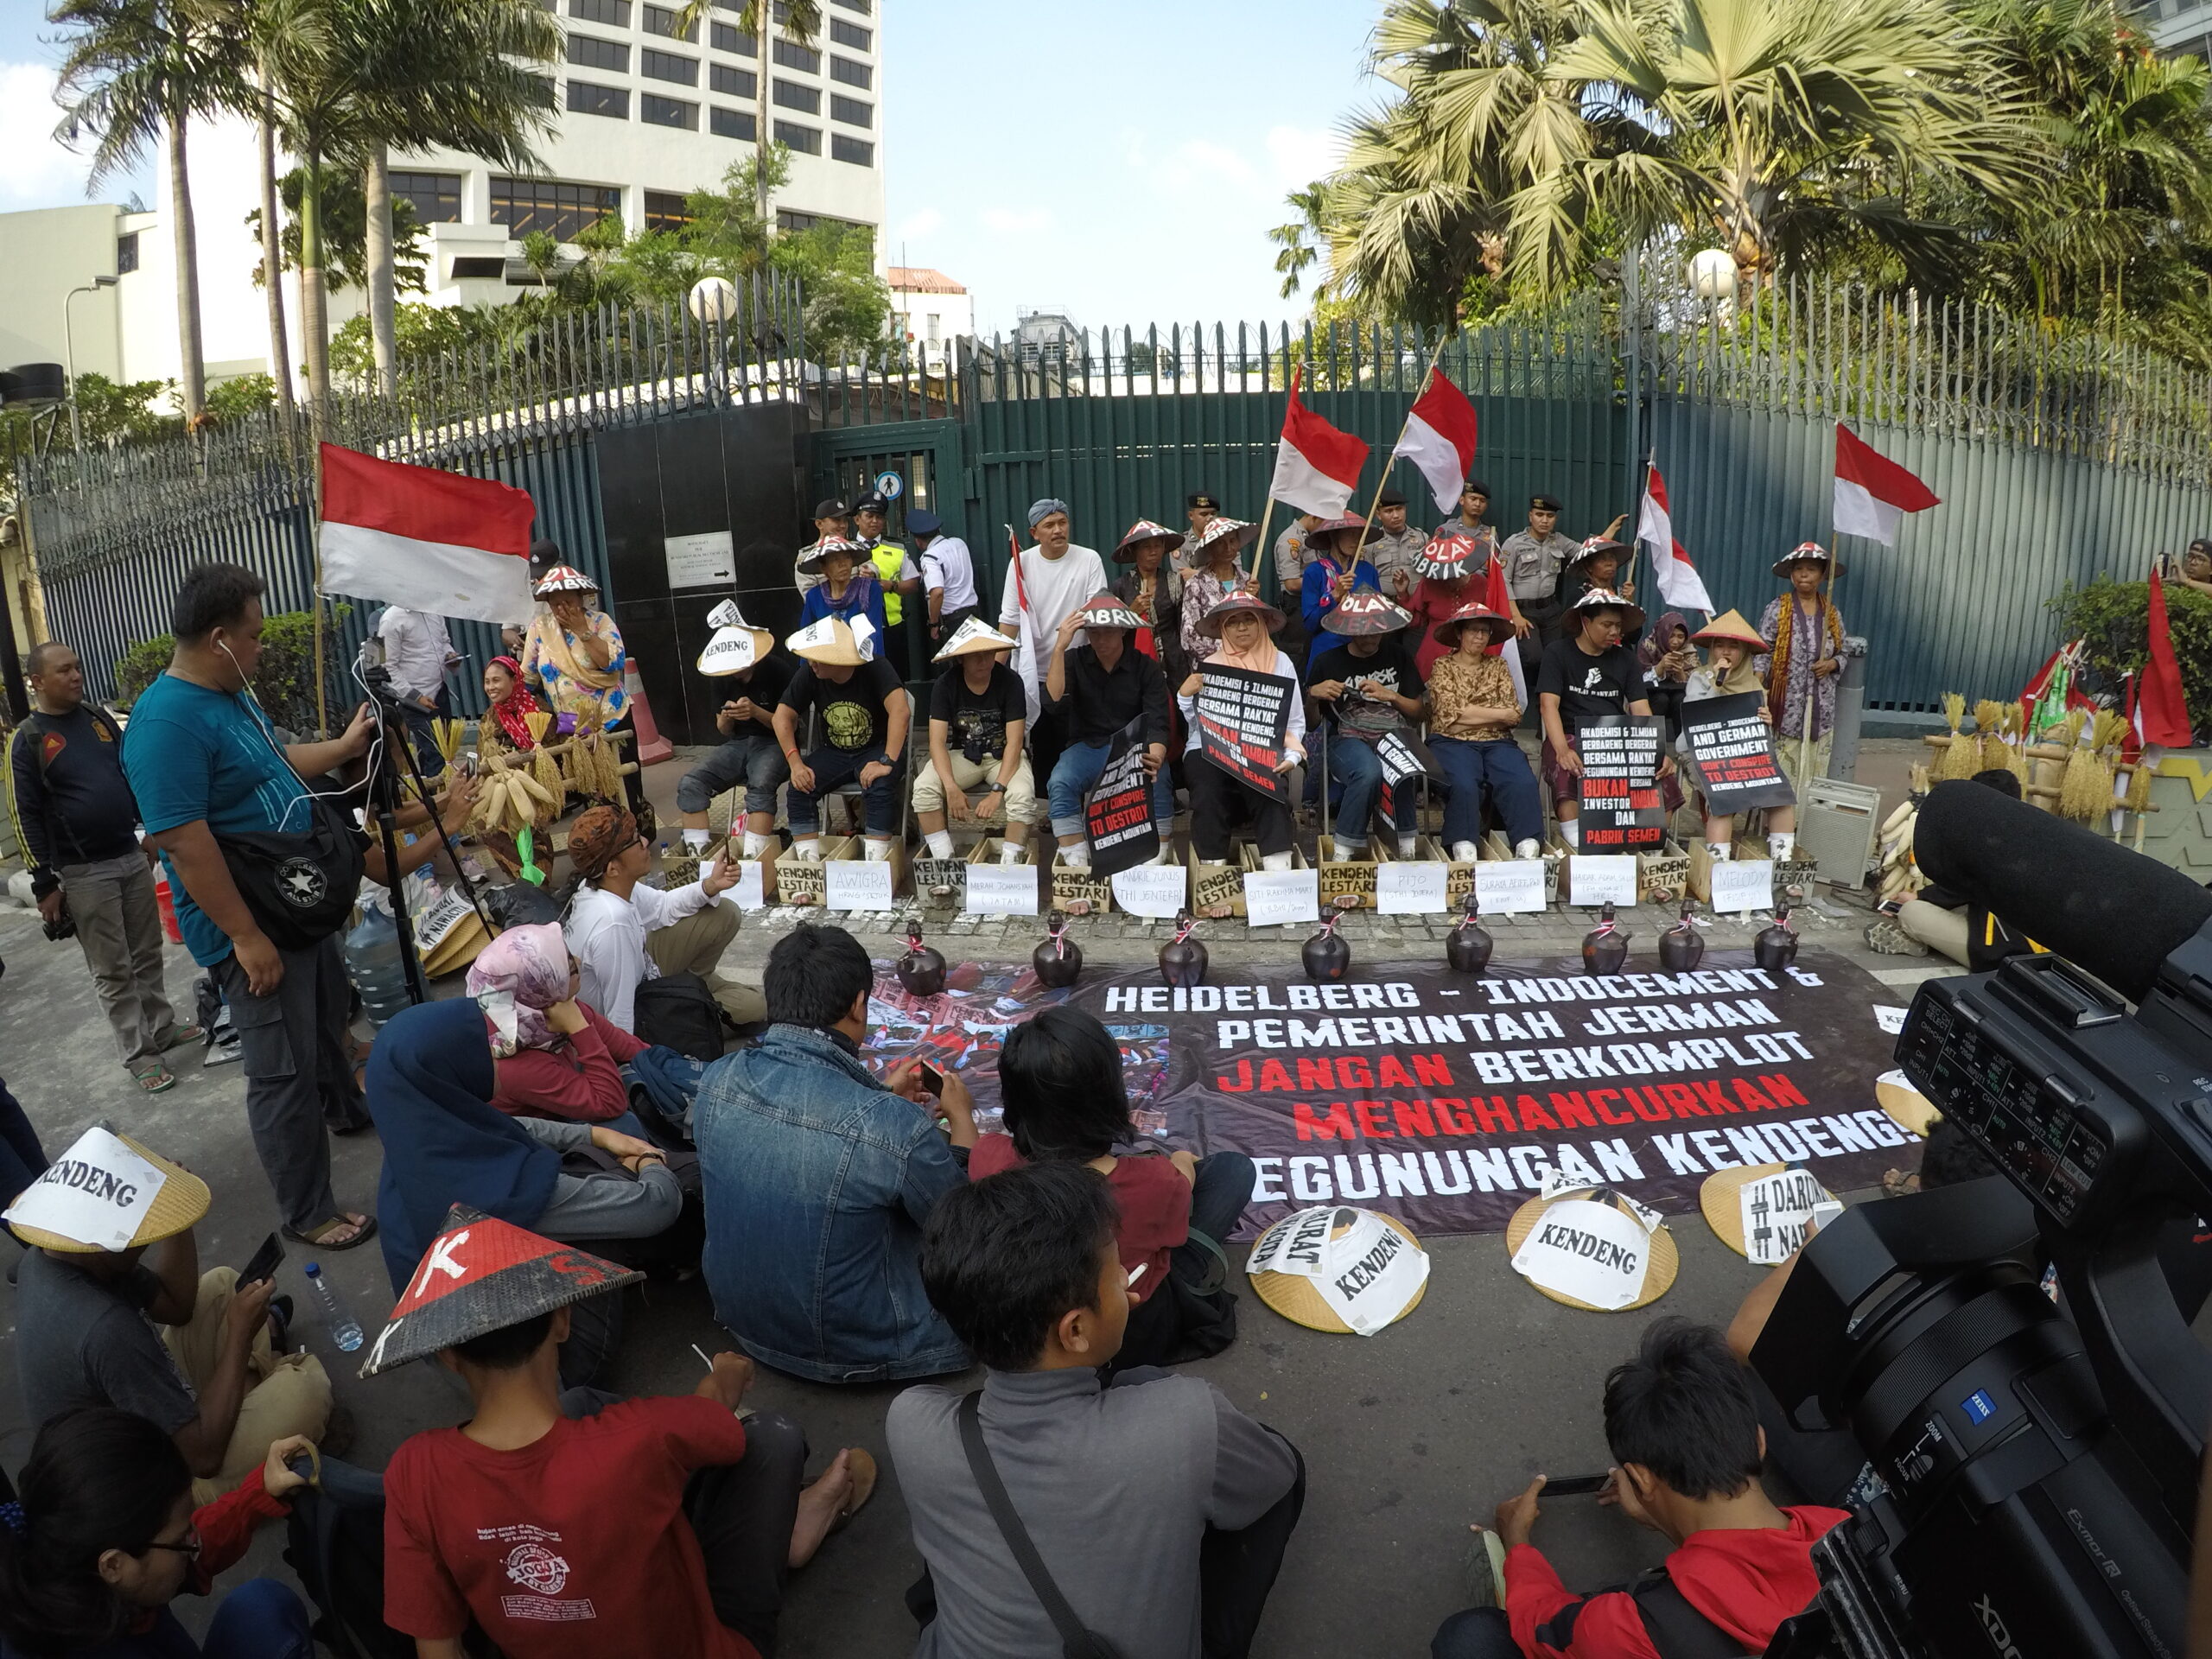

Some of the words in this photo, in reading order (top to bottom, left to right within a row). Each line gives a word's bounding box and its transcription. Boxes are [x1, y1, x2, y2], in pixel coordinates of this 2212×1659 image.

[1425, 534, 1473, 561] OLAK
[1412, 552, 1469, 580] ABRIK
[1341, 594, 1395, 613] OLAK
[1084, 609, 1151, 626] ABRIK
[1252, 683, 1284, 698] ILMUAN
[1198, 697, 1240, 717] BERSAMA
[1243, 707, 1277, 725] RAKYAT
[1243, 694, 1281, 710] BERGERAK
[1580, 727, 1621, 738] AKADEMISI
[1624, 727, 1629, 737] &
[1630, 728, 1657, 738] ILMUAN
[1693, 732, 1716, 747] AND
[1718, 724, 1766, 743] GERMAN
[1583, 753, 1625, 765] BERSAMA
[1629, 752, 1656, 764] RAKYAT
[1695, 740, 1768, 760] GOVERNMENT
[1729, 754, 1772, 768] CONSPIRE
[1243, 767, 1275, 791] SEMEN
[1705, 772, 1723, 783] TO
[1725, 766, 1777, 781] DESTROY
[1583, 779, 1628, 797] BUKAN
[1583, 798, 1630, 810] INVESTOR
[1090, 820, 1105, 836] TO
[1106, 804, 1148, 832] DESTROY
[1615, 811, 1636, 825] DAN
[1586, 830, 1624, 844] PABRIK
[1627, 828, 1661, 843] SEMEN
[777, 868, 823, 880] KENDENG
[836, 872, 888, 888] AWIGRA
[1642, 871, 1688, 890] LESTARI
[1719, 870, 1768, 887] MELODY
[779, 879, 823, 893] LESTARI
[1052, 887, 1107, 900] LESTARI
[1104, 982, 1420, 1012] HEIDELBERG
[1477, 967, 1780, 1006] INDOCEMENT
[1784, 966, 1825, 988] &
[1217, 1011, 1564, 1049] PEMERINTAH
[1582, 999, 1782, 1037] JERMAN
[1925, 1009, 1948, 1031] SELECT
[1217, 1053, 1455, 1092] JANGAN
[1470, 1031, 1815, 1084] BERKOMPLOT
[1944, 1046, 1957, 1058] ATT
[1293, 1074, 1811, 1141] MENGHANCURKAN
[1249, 1137, 1646, 1202] EGUNUNGAN
[1538, 1223, 1637, 1275] KENDENG
[1334, 1227, 1403, 1302] KENDENG
[1971, 1394, 1990, 1417] ZEISS
[1925, 1420, 1942, 1443] ZOOM
[1894, 1457, 1910, 1481] FOCUS
[2066, 1507, 2106, 1560] Exmor
[517, 1561, 565, 1578] JOGJA
[1894, 1573, 1910, 1596] MENU
[2139, 1617, 2173, 1659] SteadySh
